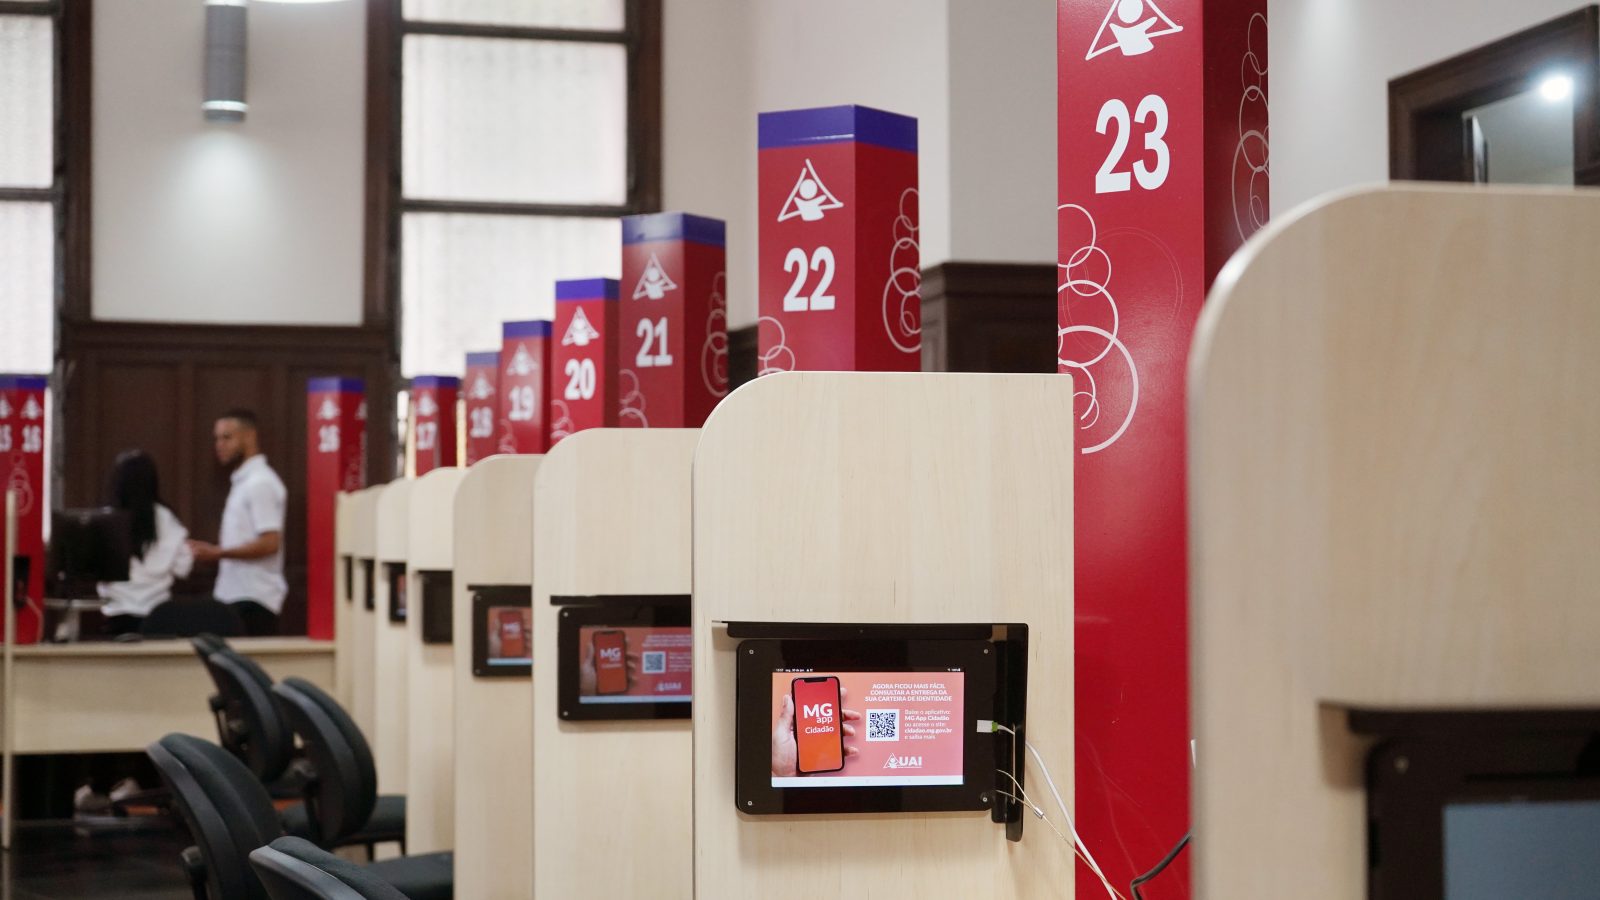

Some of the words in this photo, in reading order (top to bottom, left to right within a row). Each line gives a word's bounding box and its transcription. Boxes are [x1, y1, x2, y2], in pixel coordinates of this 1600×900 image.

[1095, 94, 1170, 194] 23
[783, 246, 836, 312] 22
[636, 317, 673, 367] 21
[564, 358, 596, 400] 20
[508, 385, 535, 421] 19
[416, 421, 437, 450] 17
[470, 406, 493, 438] 18
[600, 647, 621, 659] MG
[803, 702, 833, 719] MG
[816, 716, 833, 725] app
[804, 725, 835, 734] Cidadão
[899, 755, 922, 767] UAI
